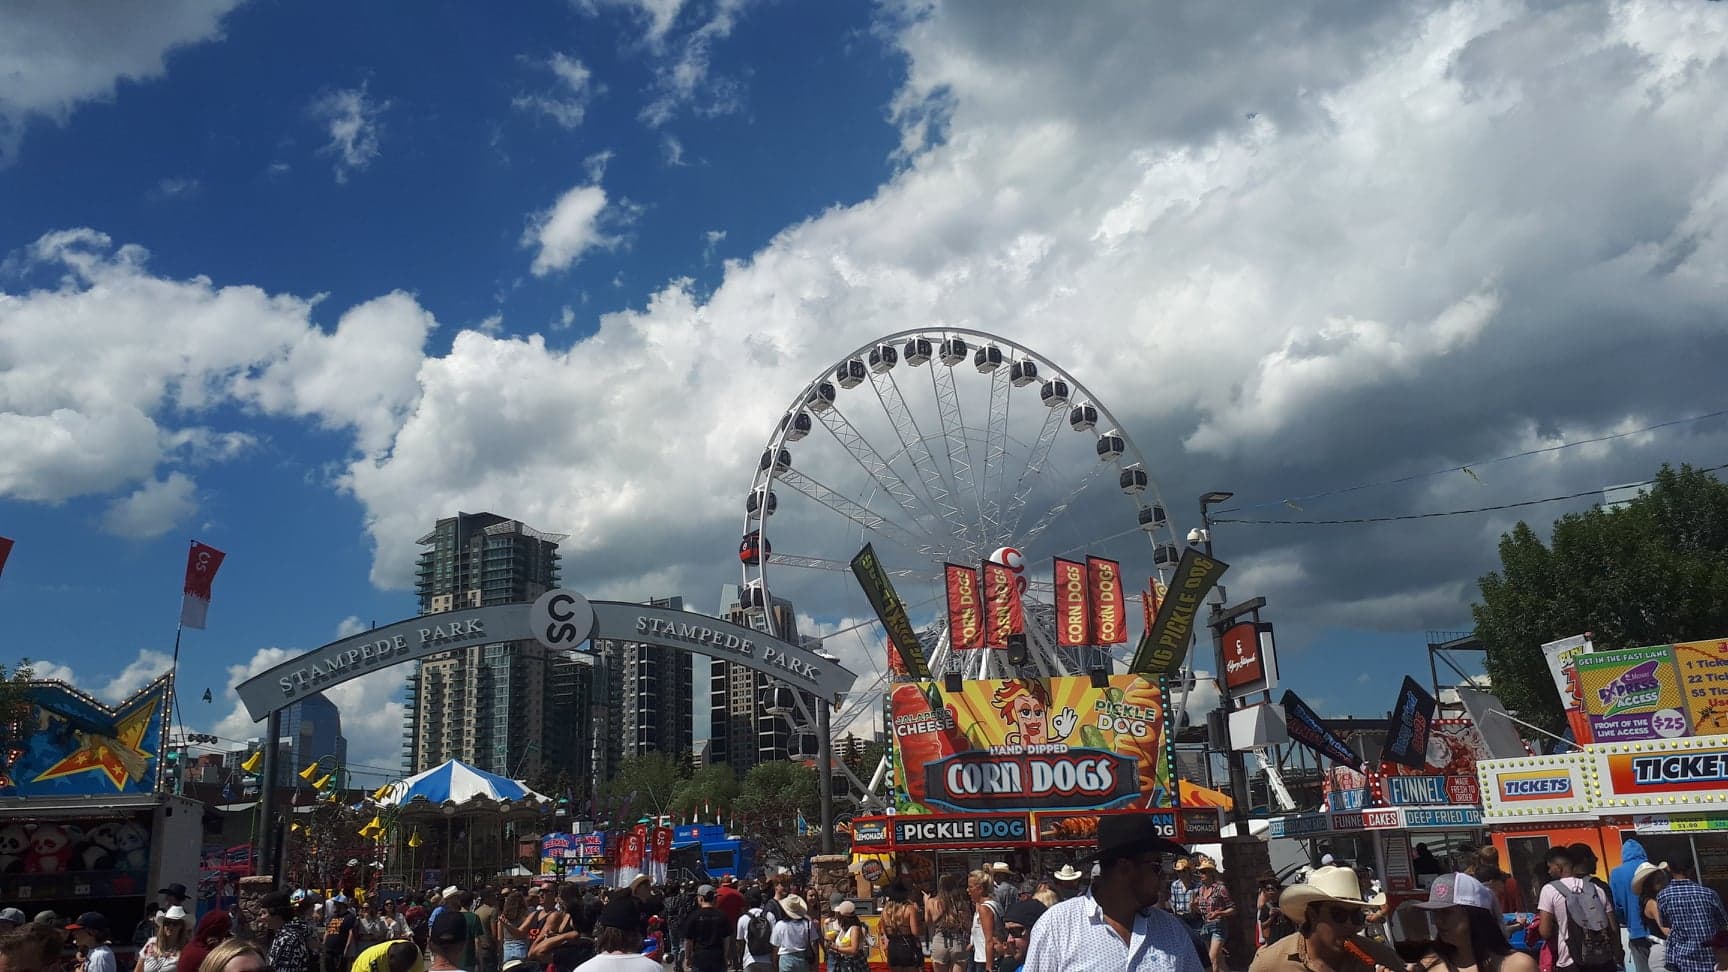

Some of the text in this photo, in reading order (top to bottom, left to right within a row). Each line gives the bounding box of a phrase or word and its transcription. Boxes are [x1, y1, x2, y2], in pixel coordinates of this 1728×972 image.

[1067, 566, 1083, 643] CORN DOGS
[1099, 563, 1115, 641] CORN DOGS
[1160, 592, 1198, 651] PICKLE
[1184, 556, 1215, 593] DOG
[278, 618, 484, 694] STAMPEDE PARK
[636, 616, 820, 681] STAMPEDE PARK
[1578, 650, 1668, 666] GET IN THE FAST LANE
[1686, 661, 1692, 669] 1
[1688, 675, 1703, 683] 22
[1599, 680, 1659, 704] EXPRESS
[1617, 692, 1658, 707] ACCESS
[1094, 699, 1156, 723] PICKLE
[897, 719, 955, 737] CHEESE
[1097, 714, 1147, 737] DOG
[1594, 719, 1648, 729] FRONT OF THE
[1653, 716, 1685, 731] $25
[1597, 728, 1649, 737] LINE ACCESS
[989, 743, 1068, 756] HAND DIPPED
[946, 758, 1116, 795] CORN DOGS
[1454, 777, 1469, 785] MADE
[1393, 777, 1443, 803] FUNNEL
[1450, 785, 1467, 794] FRESH
[1505, 779, 1568, 794] TICKETS
[1455, 793, 1473, 801] ORDER
[1335, 814, 1367, 828] FUNNEL
[1368, 812, 1397, 826] CAKES
[1407, 811, 1432, 825] DEEP
[1434, 809, 1464, 824] FRIED
[856, 832, 885, 841] LEMONADE
[904, 822, 974, 840] PICKLE
[978, 820, 1025, 838] DOG
[1186, 824, 1216, 833] LEMONADE
